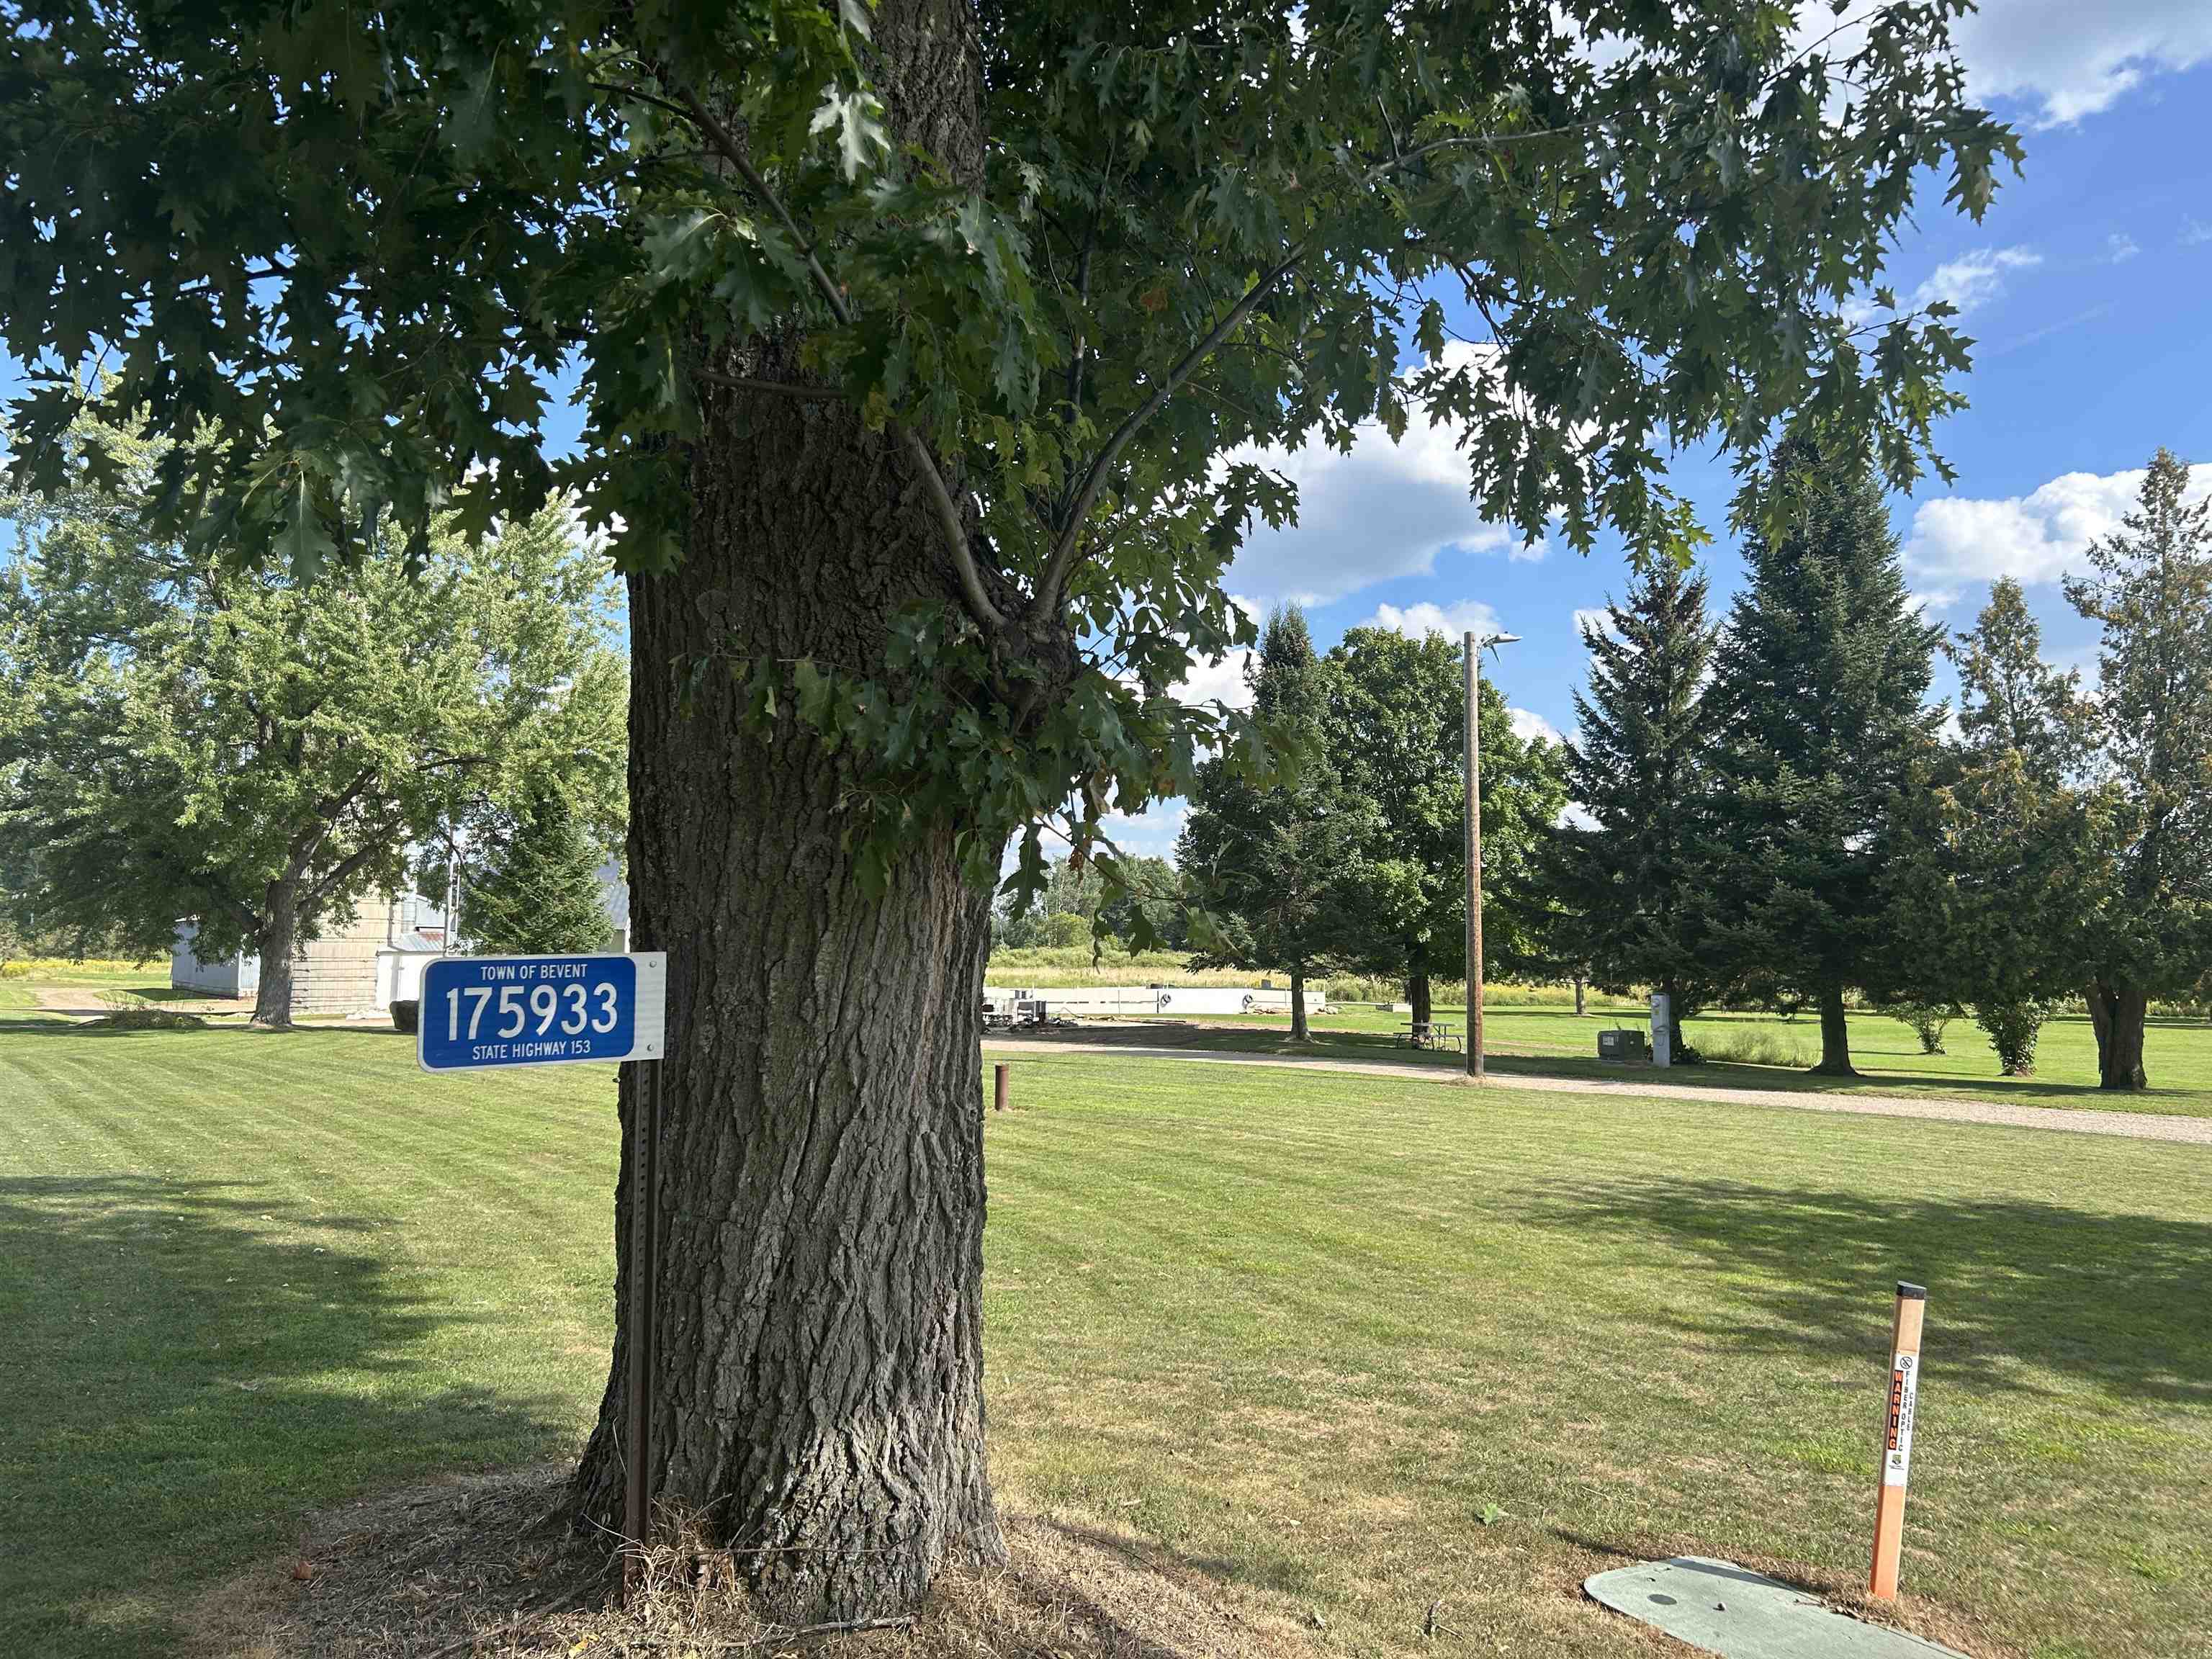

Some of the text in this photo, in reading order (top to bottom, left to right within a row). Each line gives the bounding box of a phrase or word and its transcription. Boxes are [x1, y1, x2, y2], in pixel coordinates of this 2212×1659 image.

[481, 963, 588, 980] TOWN OF BEVENT
[446, 982, 617, 1041] 175933
[472, 1040, 591, 1060] STATE HIGHWAY 153
[1889, 1371, 1902, 1449] WARNING
